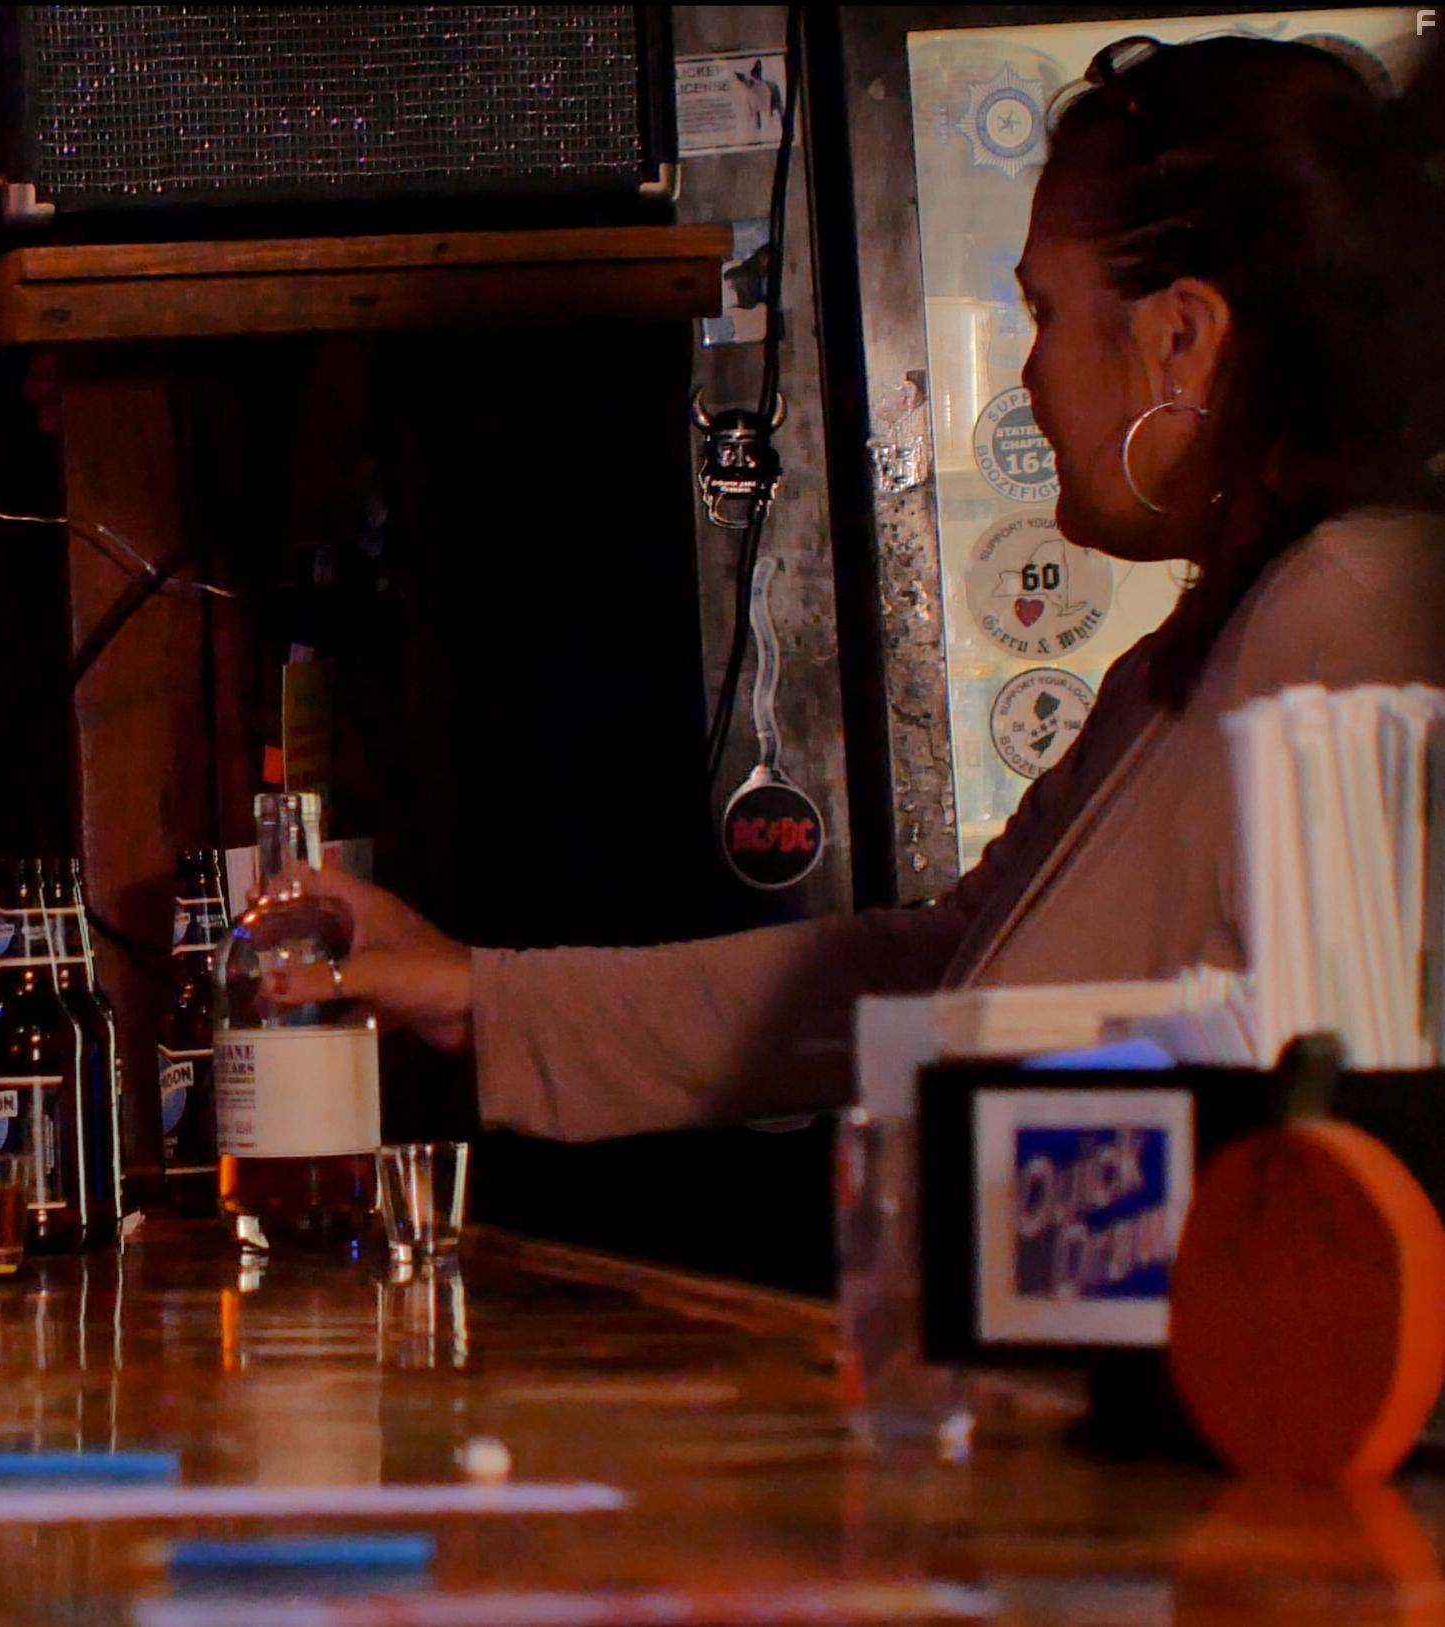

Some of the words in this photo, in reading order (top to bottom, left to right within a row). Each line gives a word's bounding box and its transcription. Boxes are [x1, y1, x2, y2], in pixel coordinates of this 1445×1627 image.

[676, 80, 730, 95] ICENSE
[1006, 451, 1056, 475] 164
[980, 520, 1023, 561] SUPPORT
[1022, 563, 1060, 591] 60
[983, 614, 1029, 653] Green
[1037, 637, 1050, 654] &
[1056, 608, 1103, 649] White
[1039, 677, 1068, 686] YOUR
